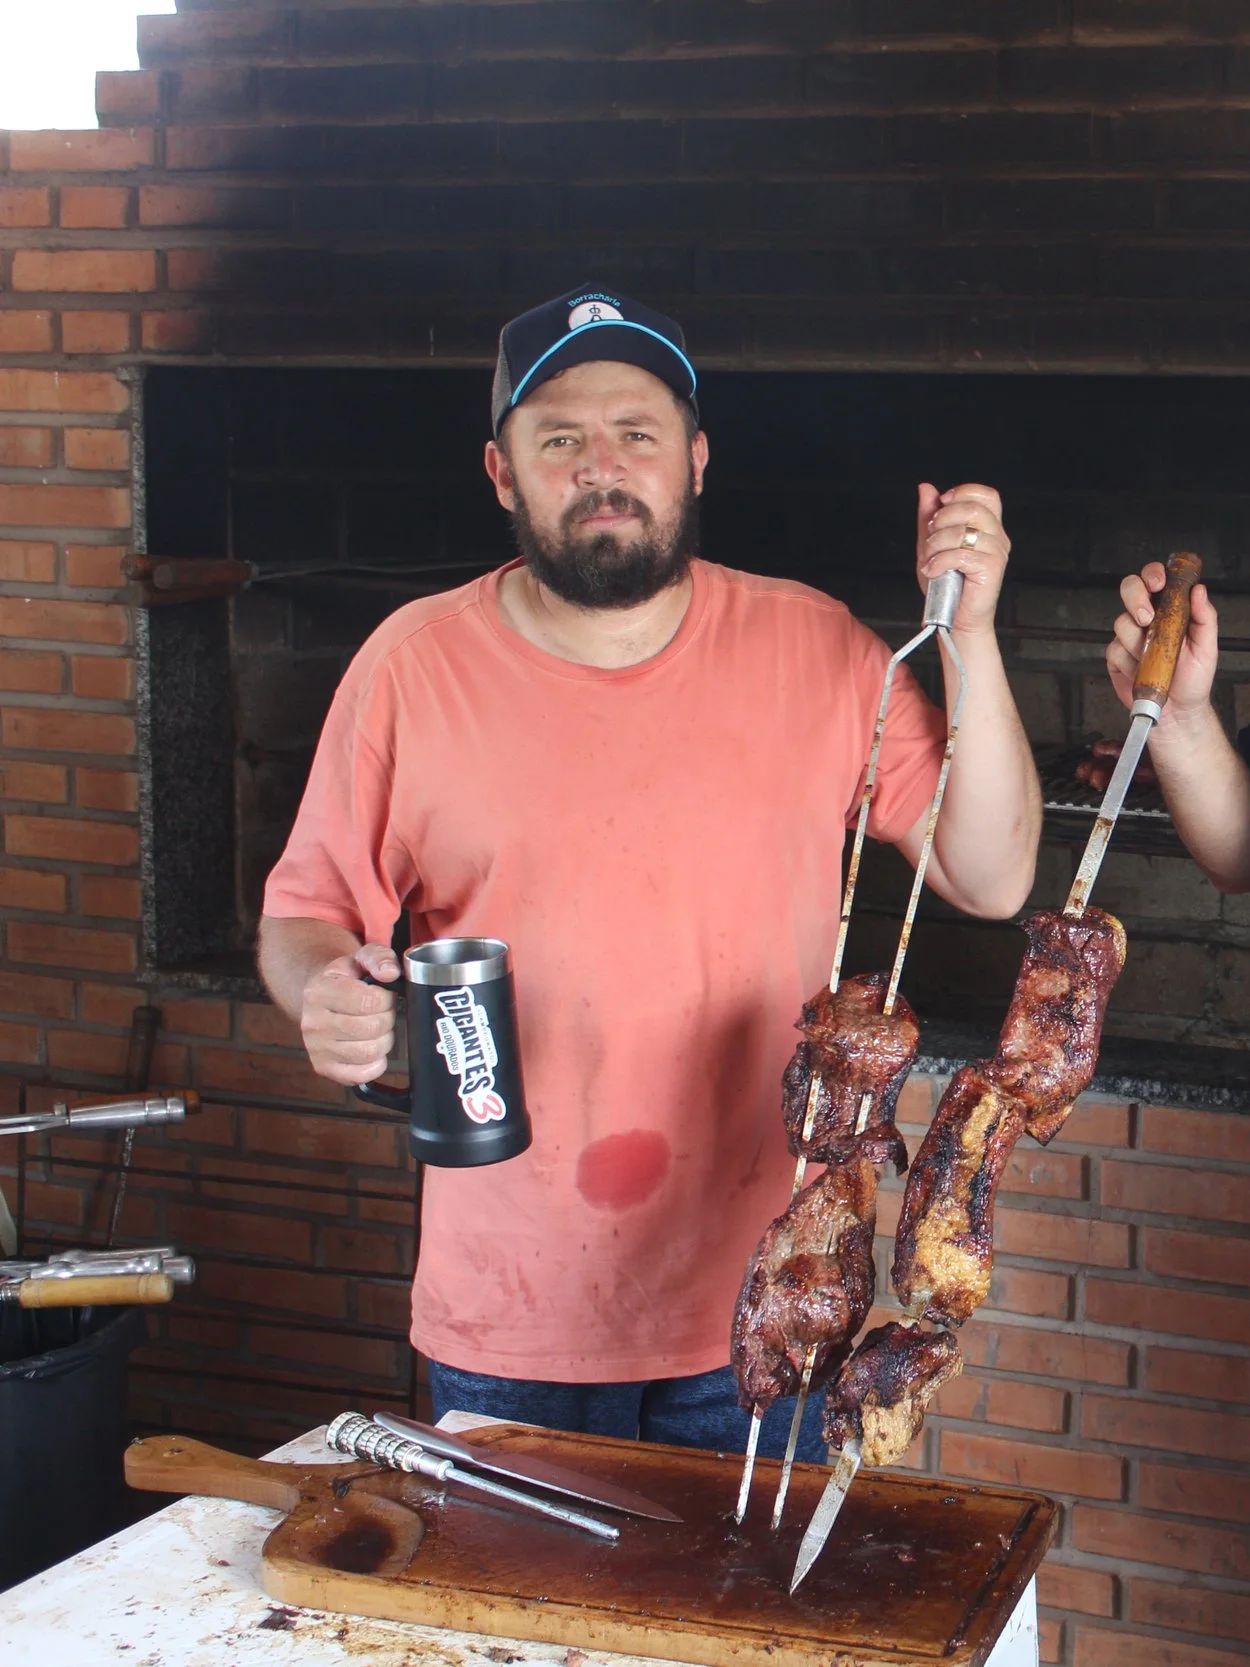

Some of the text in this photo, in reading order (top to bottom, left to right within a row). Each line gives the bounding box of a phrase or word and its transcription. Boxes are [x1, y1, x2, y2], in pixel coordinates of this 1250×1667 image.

[438, 991, 503, 1119] GIGANTES 3
[440, 1022, 459, 1071] RIO DOURADOS
